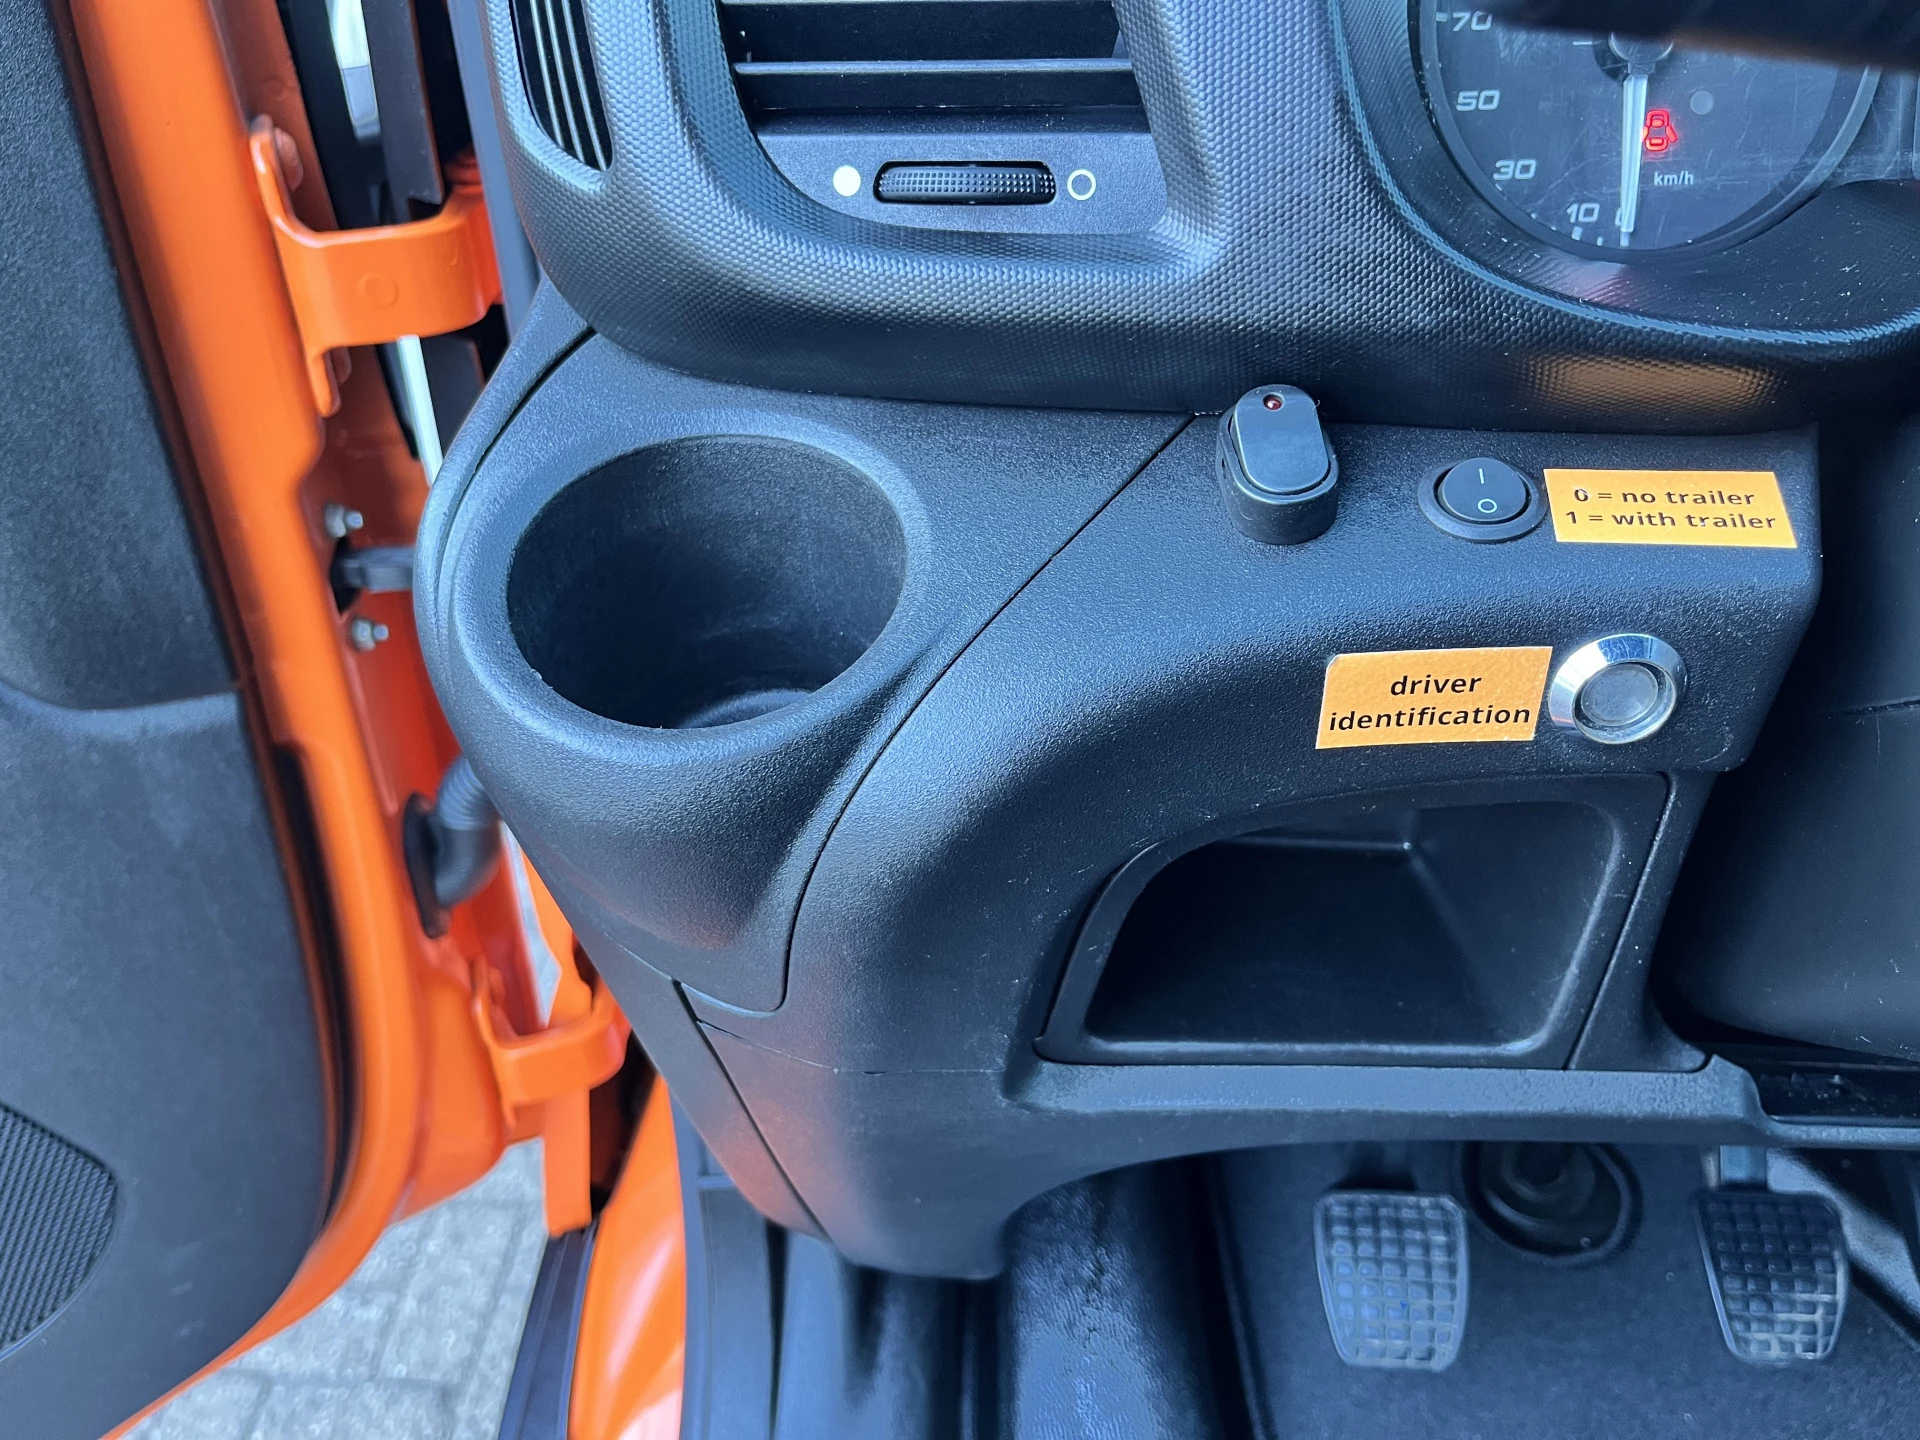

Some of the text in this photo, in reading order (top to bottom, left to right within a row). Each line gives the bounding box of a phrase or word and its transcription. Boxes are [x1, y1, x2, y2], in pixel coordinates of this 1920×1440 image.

[1452, 11, 1493, 32] 70
[1456, 90, 1500, 111] 50
[1493, 159, 1536, 180] 30
[1653, 170, 1694, 187] km/h
[1566, 202, 1600, 224] 10
[1573, 488, 1755, 505] 0 = no trailer
[1565, 511, 1777, 529] 1 = with trailer
[1390, 673, 1483, 696] driver
[1329, 705, 1531, 731] identification
